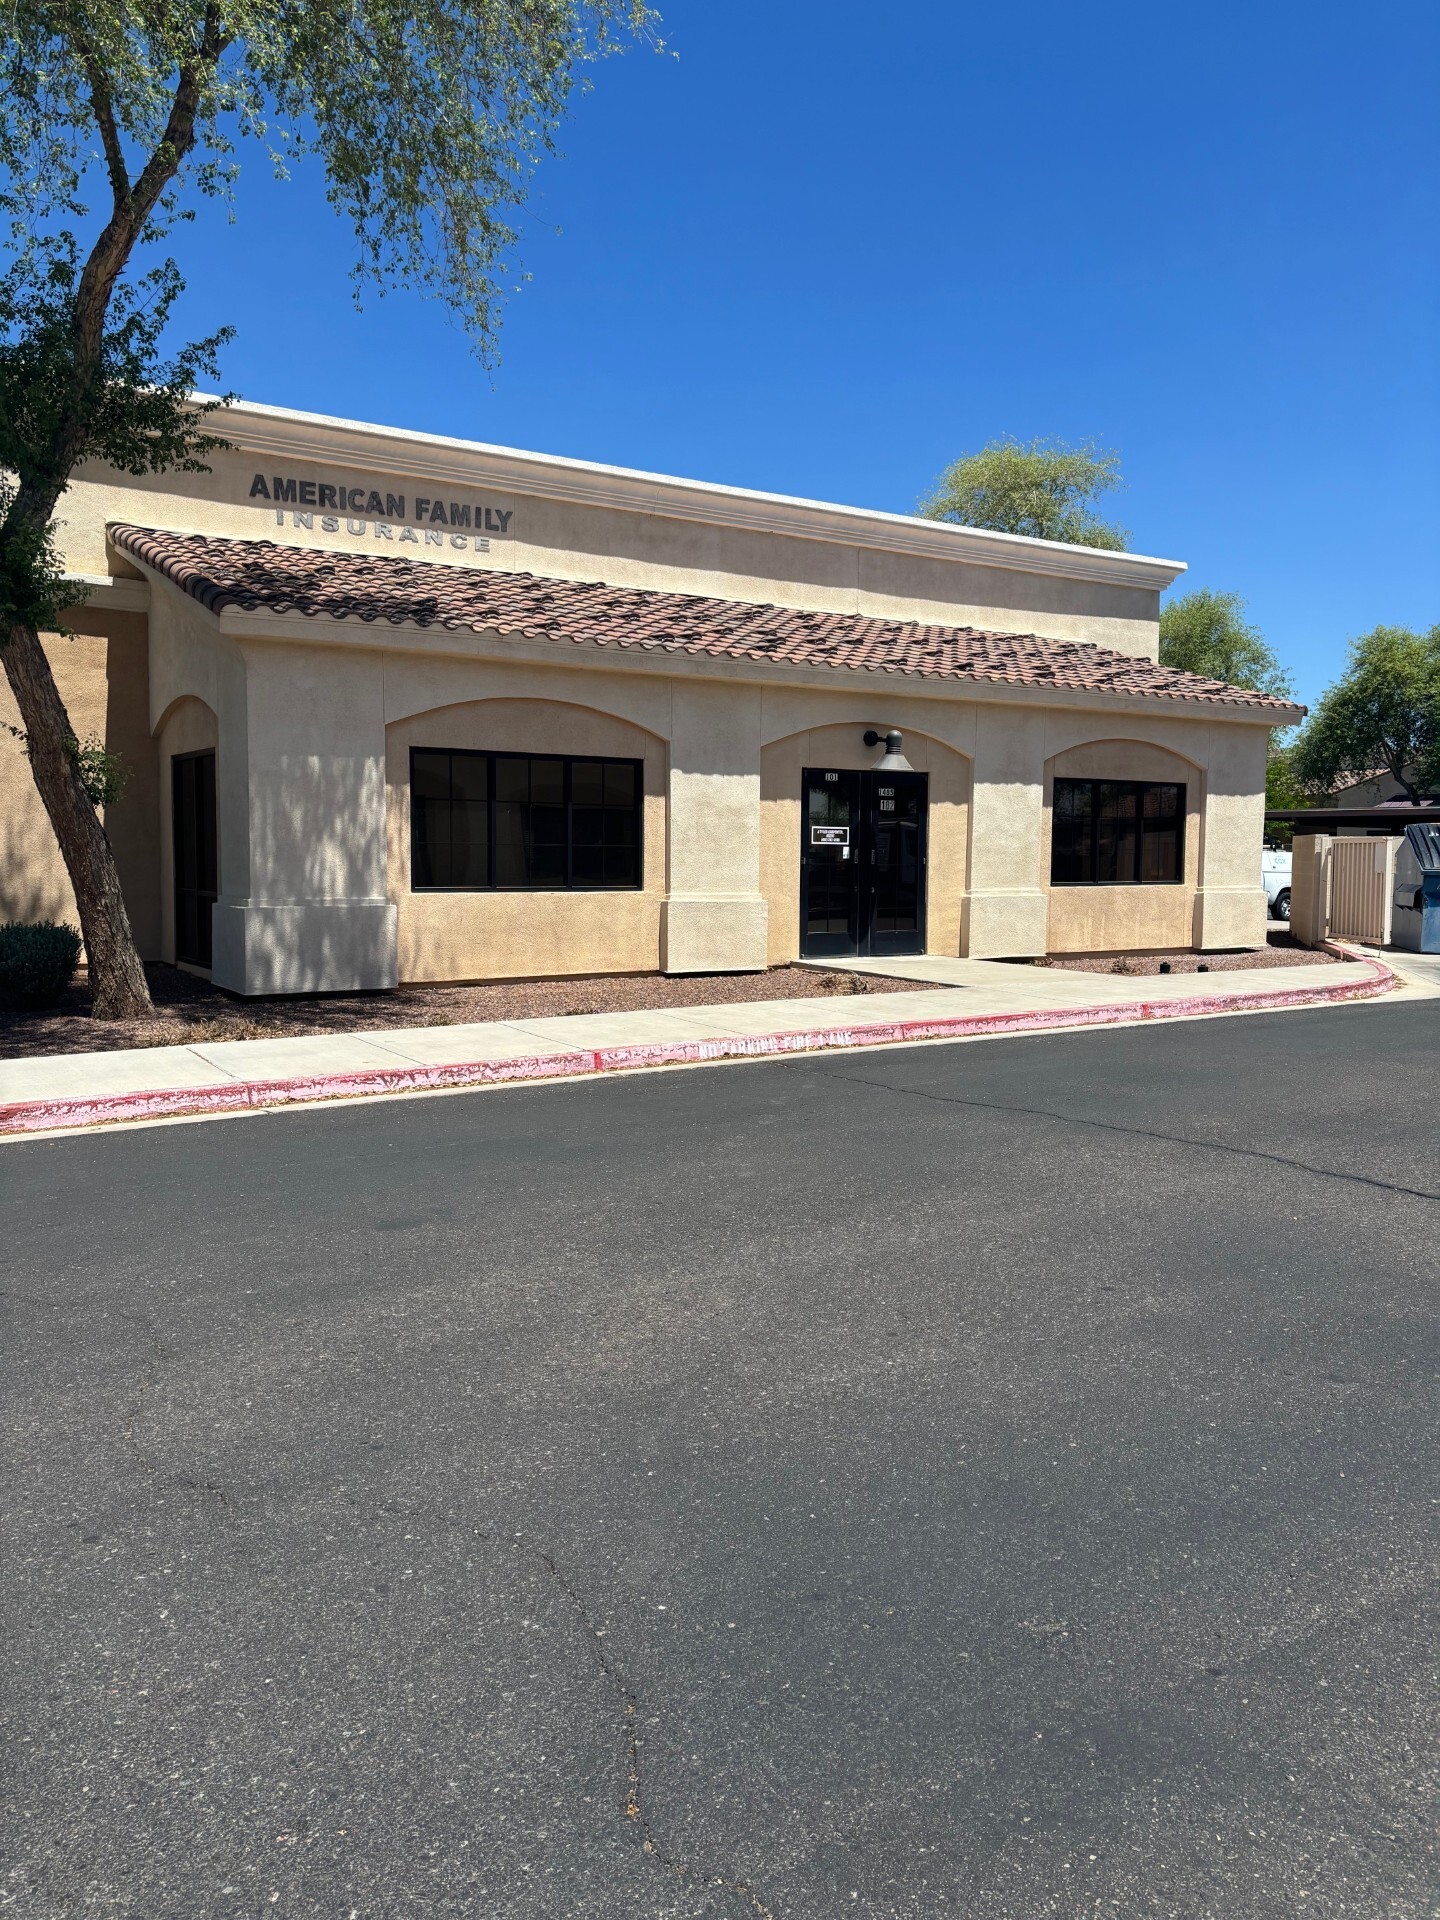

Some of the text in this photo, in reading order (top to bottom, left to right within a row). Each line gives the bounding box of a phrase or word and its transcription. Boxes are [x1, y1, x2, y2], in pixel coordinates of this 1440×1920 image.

[248, 473, 514, 533] AMERICAN FAMILY
[275, 507, 491, 553] INSURANCE
[826, 773, 838, 781] 101
[881, 800, 895, 810] 102
[698, 1043, 718, 1059] NO
[720, 1037, 779, 1054] PARKING
[784, 1034, 812, 1049] FIRE
